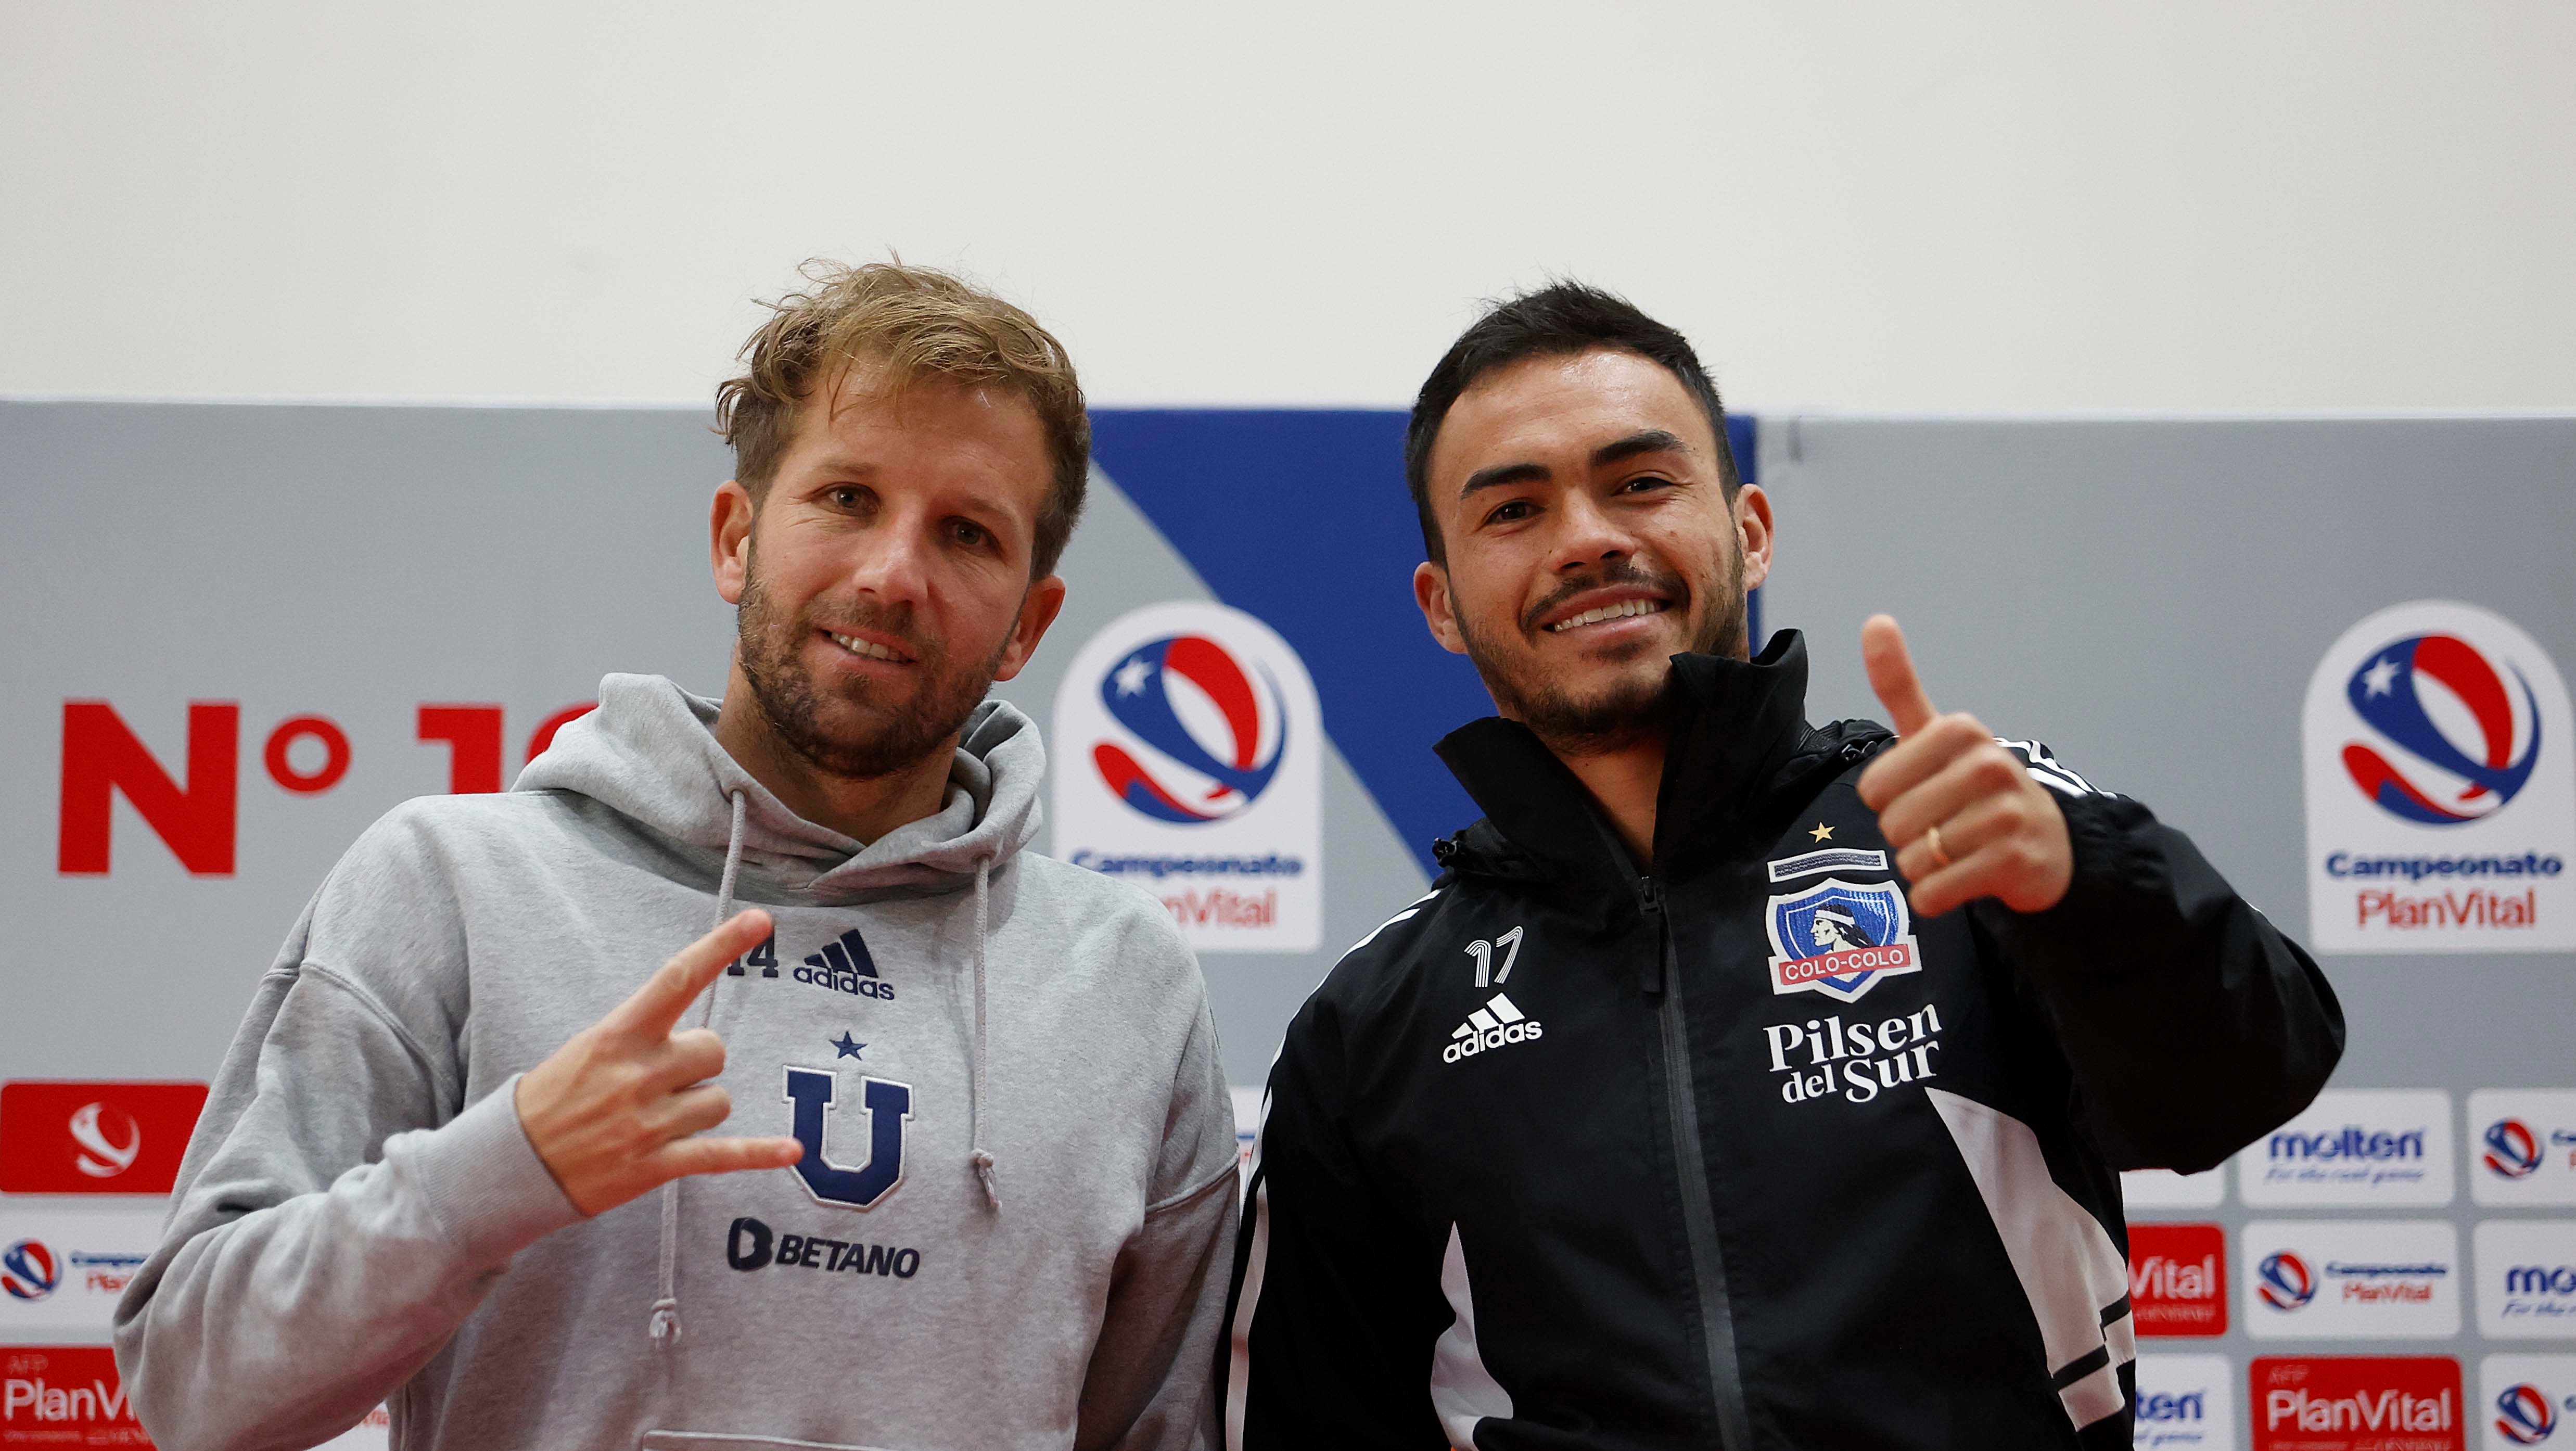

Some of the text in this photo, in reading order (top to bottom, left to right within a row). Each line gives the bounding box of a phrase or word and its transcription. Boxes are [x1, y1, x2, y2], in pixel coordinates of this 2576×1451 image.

[2325, 849, 2564, 883] Campeonato
[2356, 886, 2536, 928] PlanVital
[1464, 925, 1523, 987] 17
[1785, 949, 1904, 981] COLO-COLO
[793, 966, 895, 1000] adidas
[1443, 1021, 1543, 1063] adidas
[1763, 1003, 1942, 1072] Pilsen
[1782, 1040, 1940, 1103] del Sur
[782, 1065, 915, 1213] U
[2268, 1124, 2426, 1161] molten
[775, 1234, 921, 1279] BETANO
[2266, 1388, 2452, 1432] PlanVital
